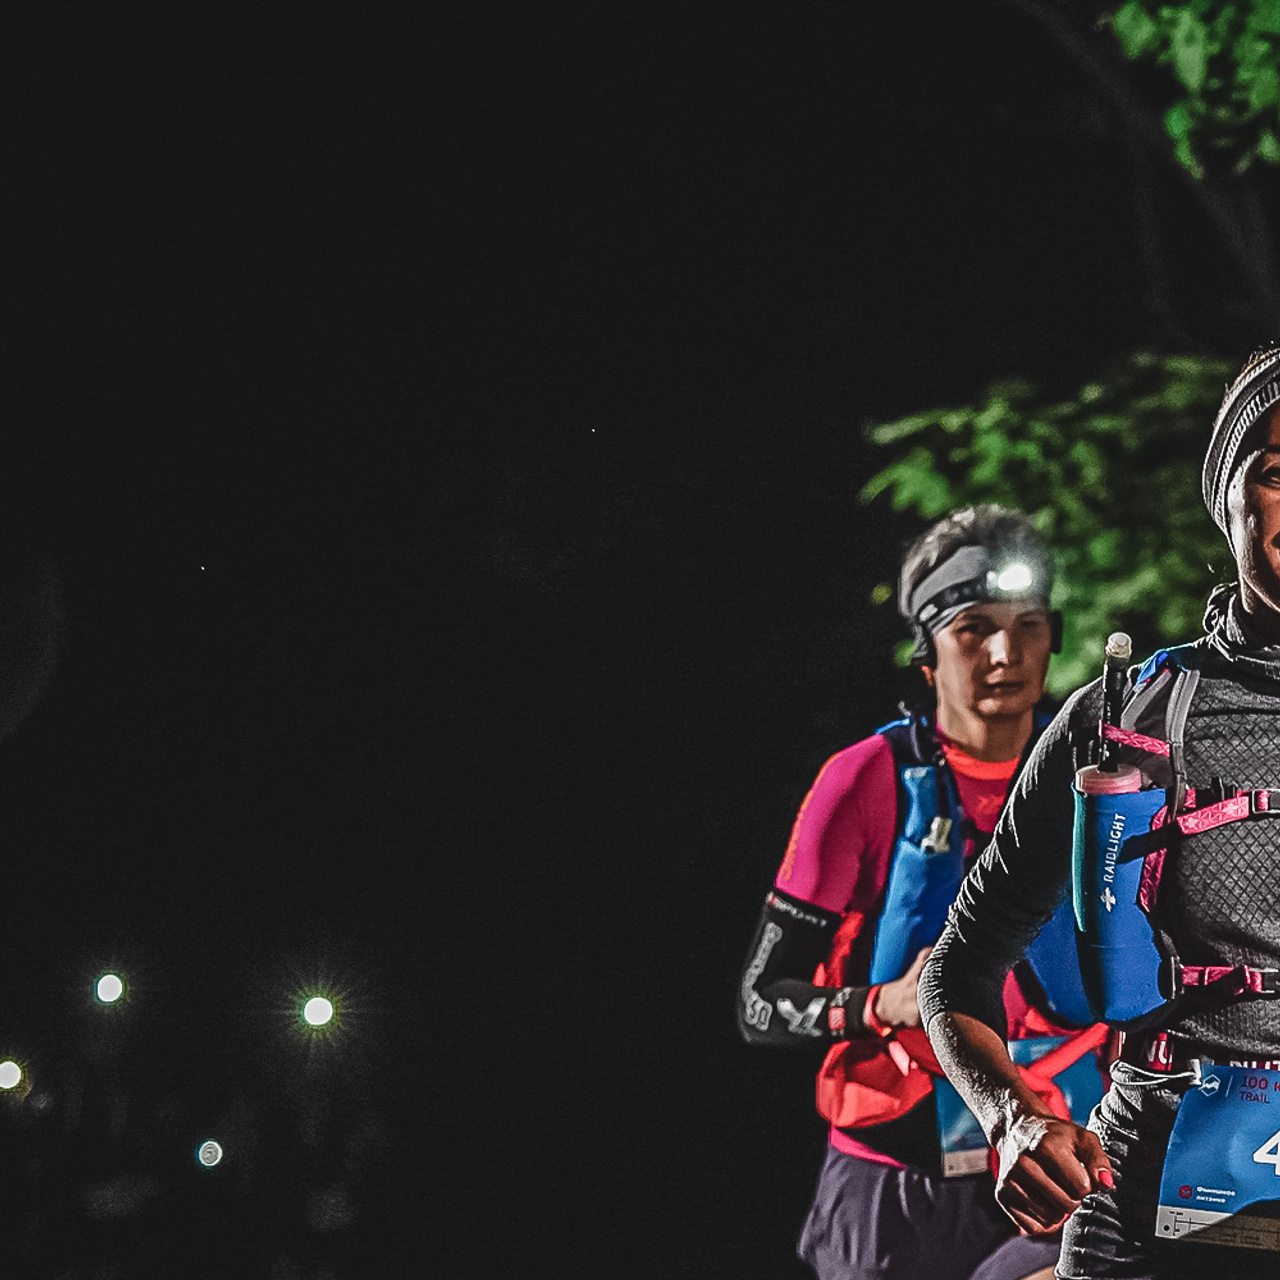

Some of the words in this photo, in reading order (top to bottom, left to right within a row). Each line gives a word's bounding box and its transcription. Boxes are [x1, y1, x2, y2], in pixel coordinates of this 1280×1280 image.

[1103, 812, 1127, 883] RAIDLIGHT
[1241, 1076, 1269, 1091] 100
[1240, 1091, 1270, 1105] TRAIL
